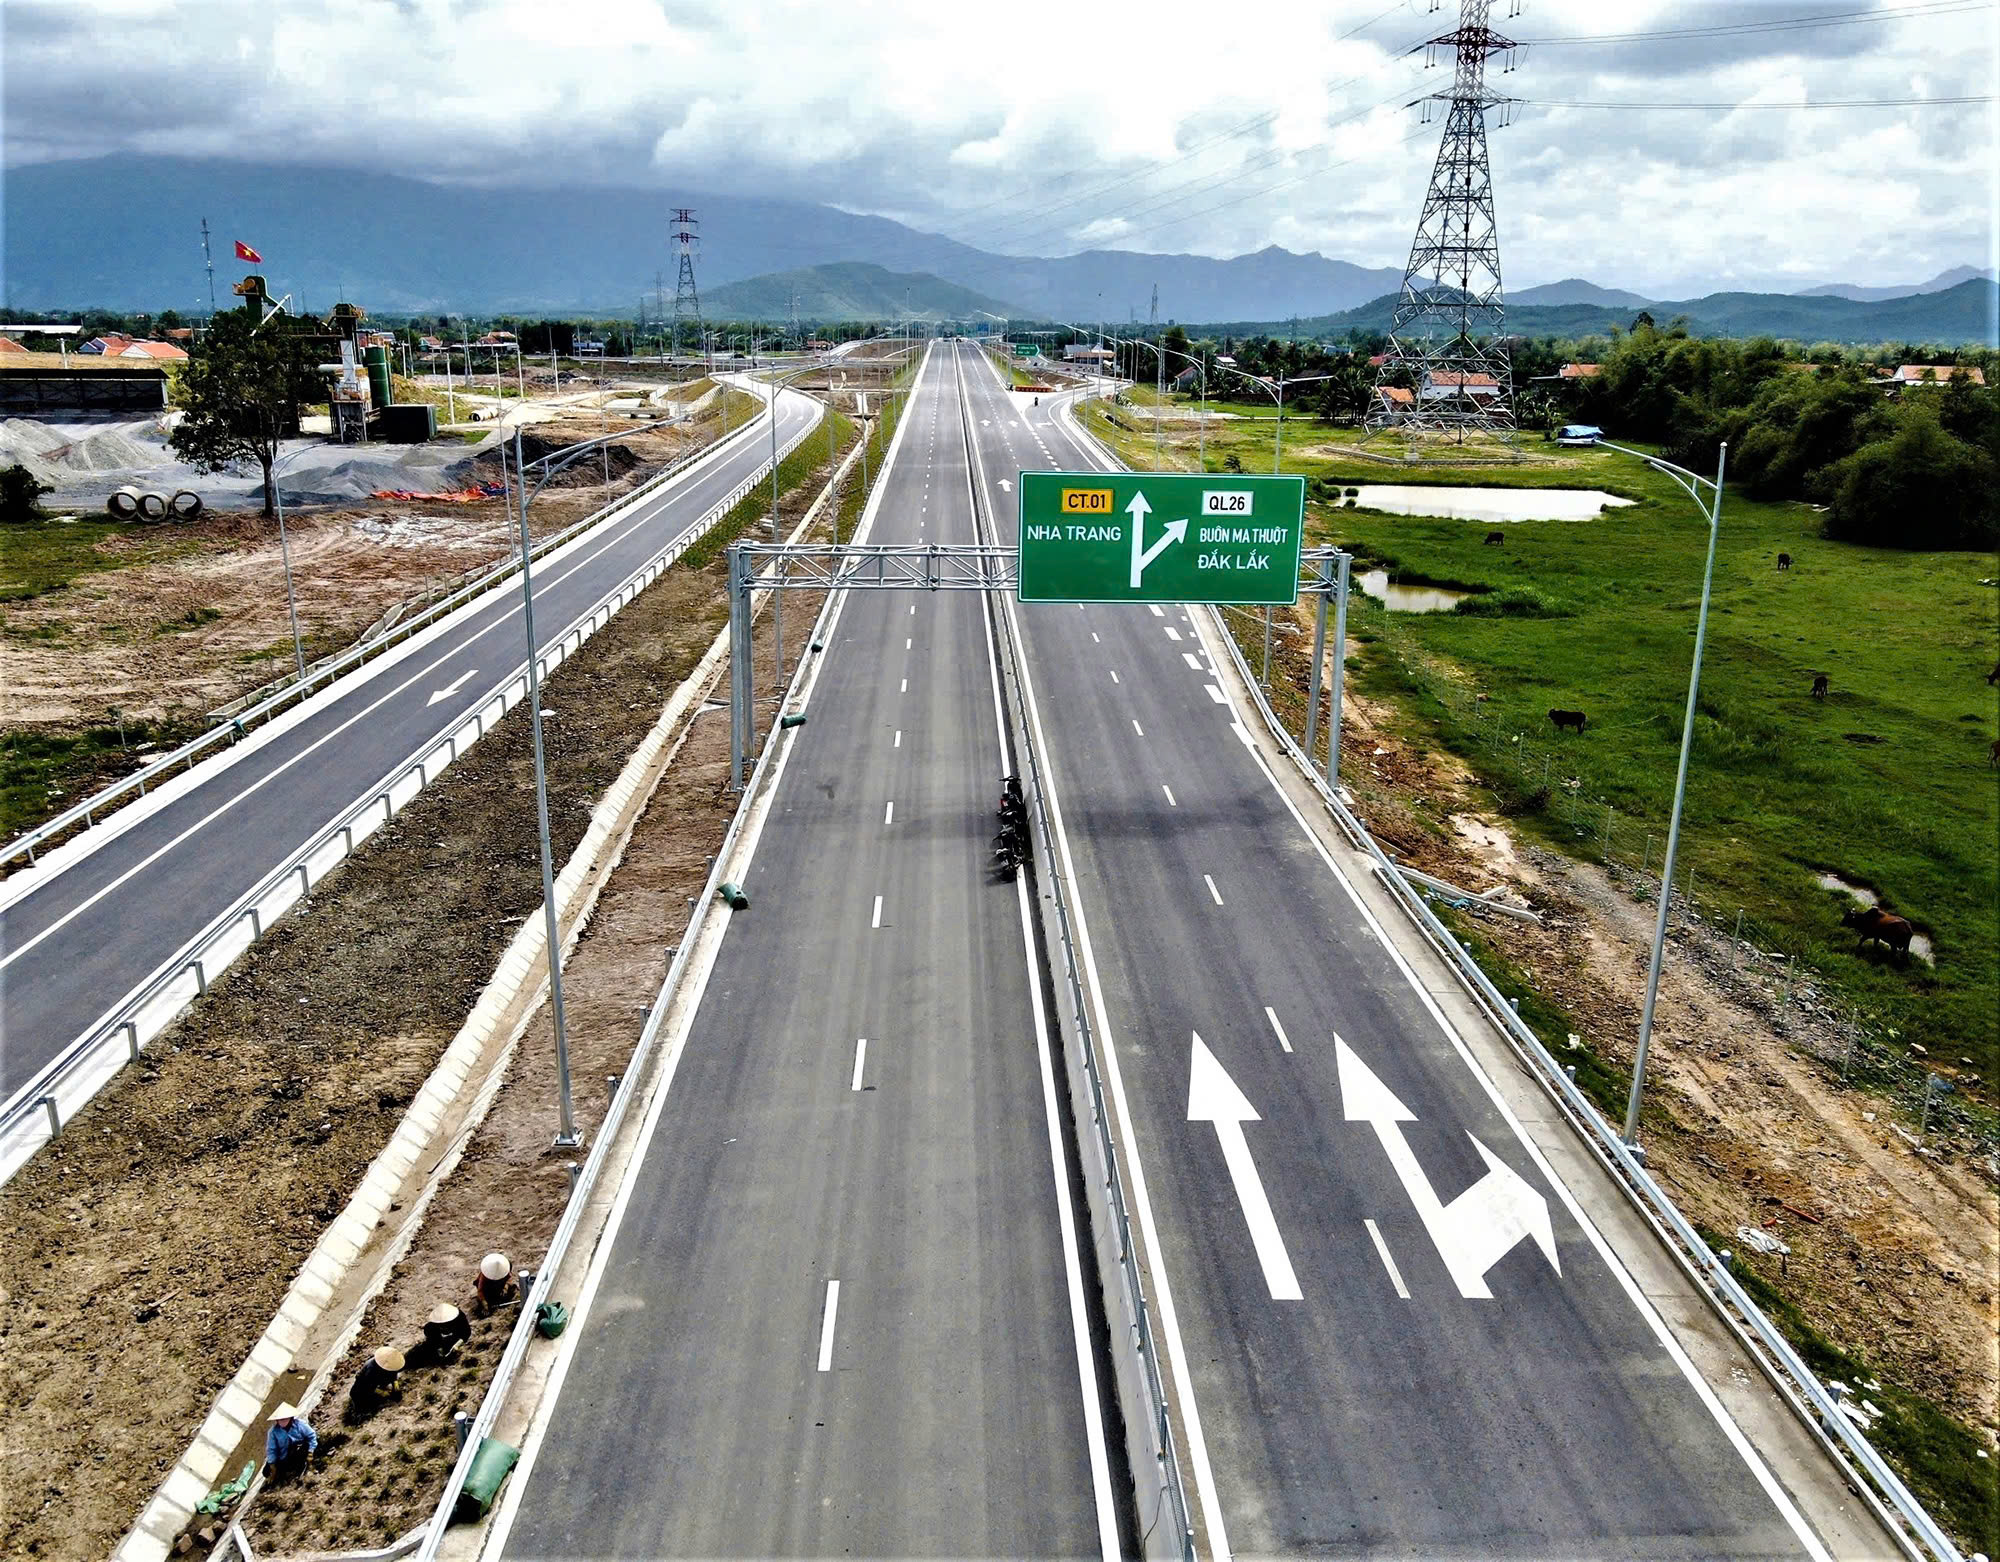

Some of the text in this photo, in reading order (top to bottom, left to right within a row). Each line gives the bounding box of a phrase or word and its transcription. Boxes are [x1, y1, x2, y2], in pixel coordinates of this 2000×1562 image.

[1068, 494, 1105, 509] CT.01
[1209, 496, 1245, 511] QL26
[1027, 525, 1121, 541] NHA TRANG
[1200, 525, 1288, 545] BUÔN MA THUỘT
[1198, 549, 1270, 570] ĐẮK LẮK
